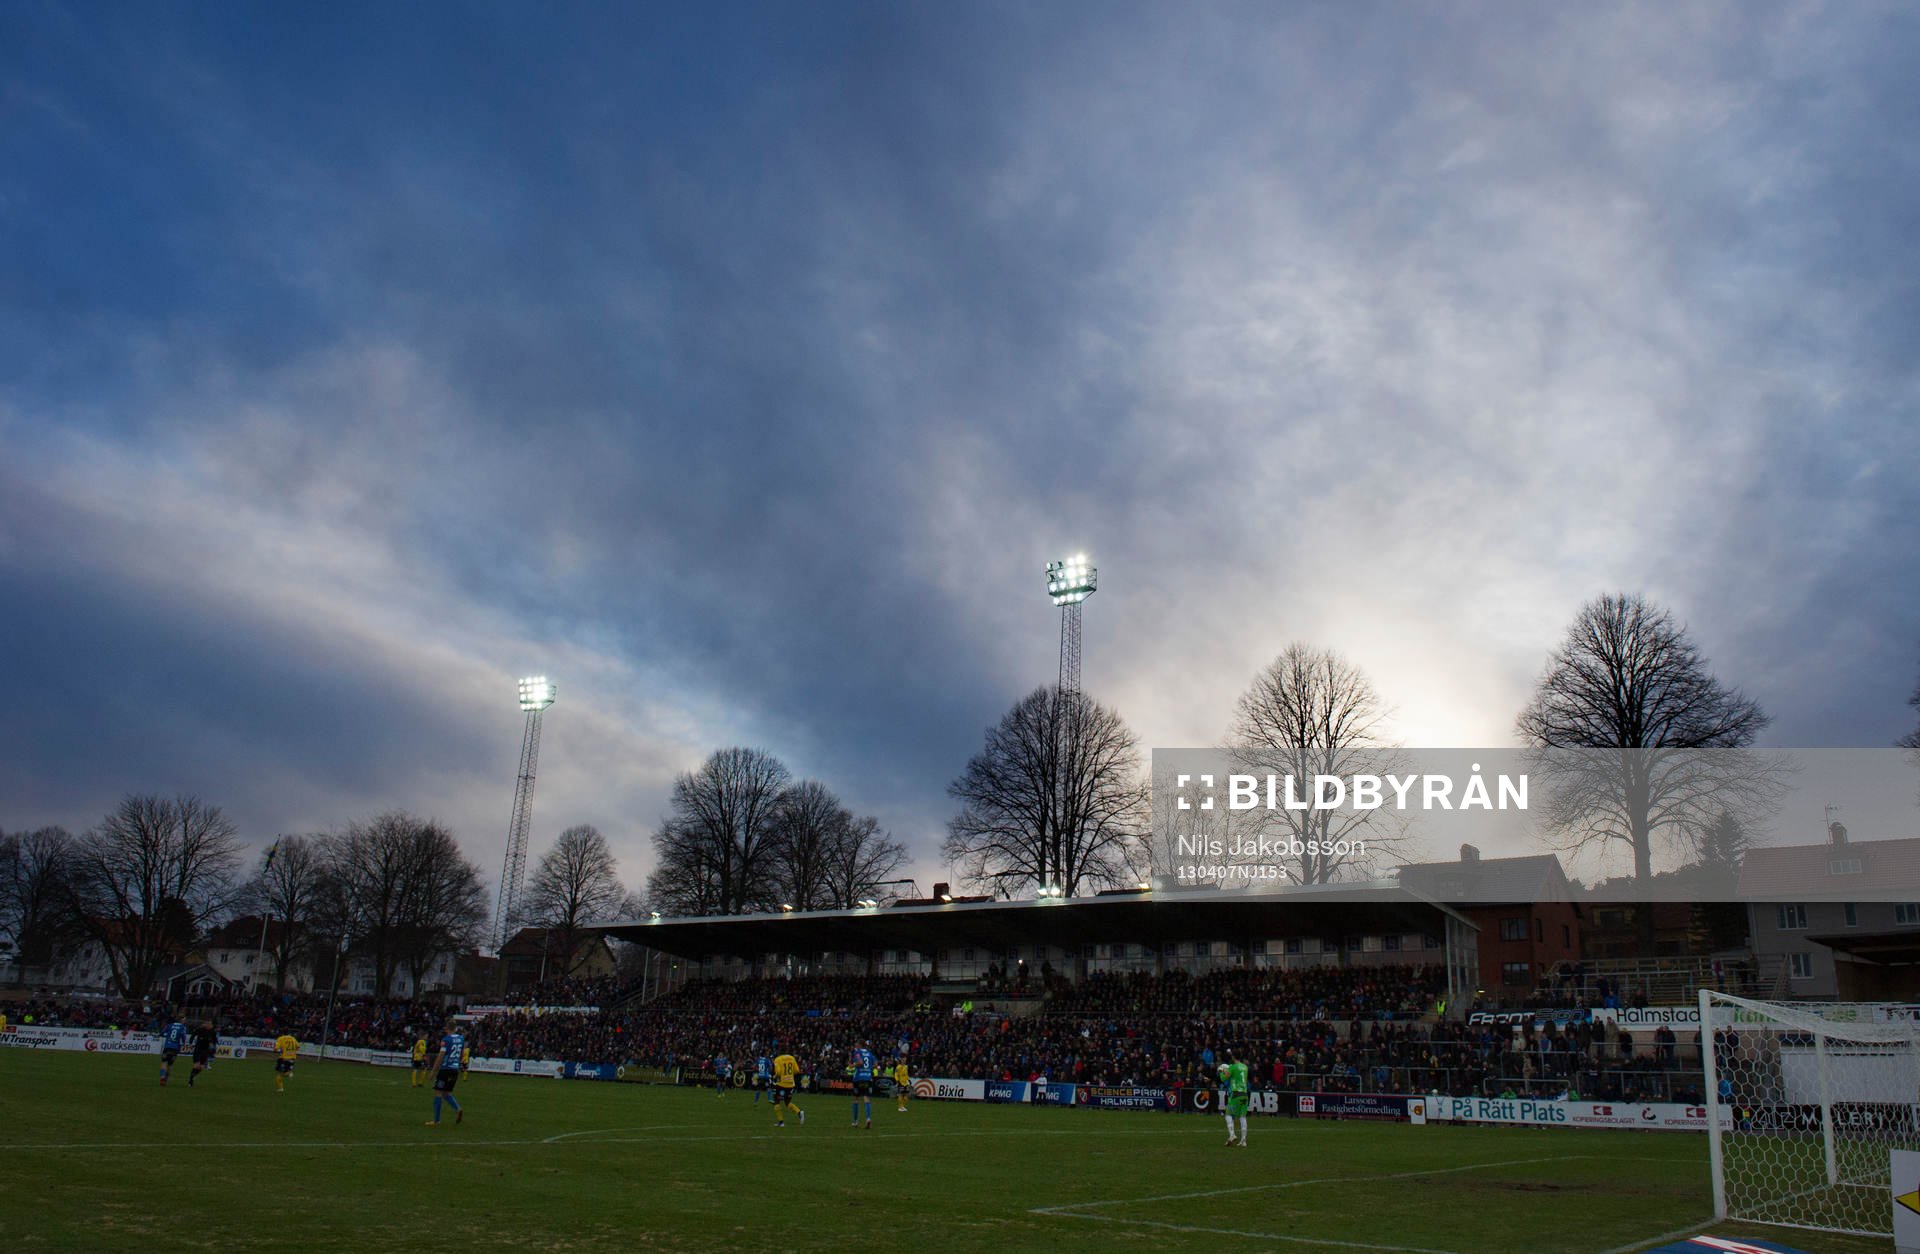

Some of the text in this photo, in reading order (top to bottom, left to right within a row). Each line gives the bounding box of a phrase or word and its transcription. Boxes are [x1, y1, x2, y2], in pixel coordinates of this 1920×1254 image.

[1617, 1007, 1701, 1022] Halmstad
[10, 1034, 58, 1048] Transport
[170, 1029, 177, 1041] 8
[101, 1040, 151, 1051] quicksearch
[449, 1044, 463, 1058] 25
[863, 1056, 870, 1069] 3
[783, 1063, 793, 1075] 18
[938, 1085, 964, 1097] Bixia
[988, 1088, 1012, 1099] KPMG
[1100, 1097, 1154, 1107] HALMSTAD
[1217, 1090, 1279, 1113] IAB
[1344, 1095, 1377, 1105] Larssons
[1452, 1098, 1566, 1122] På Rätt Plats
